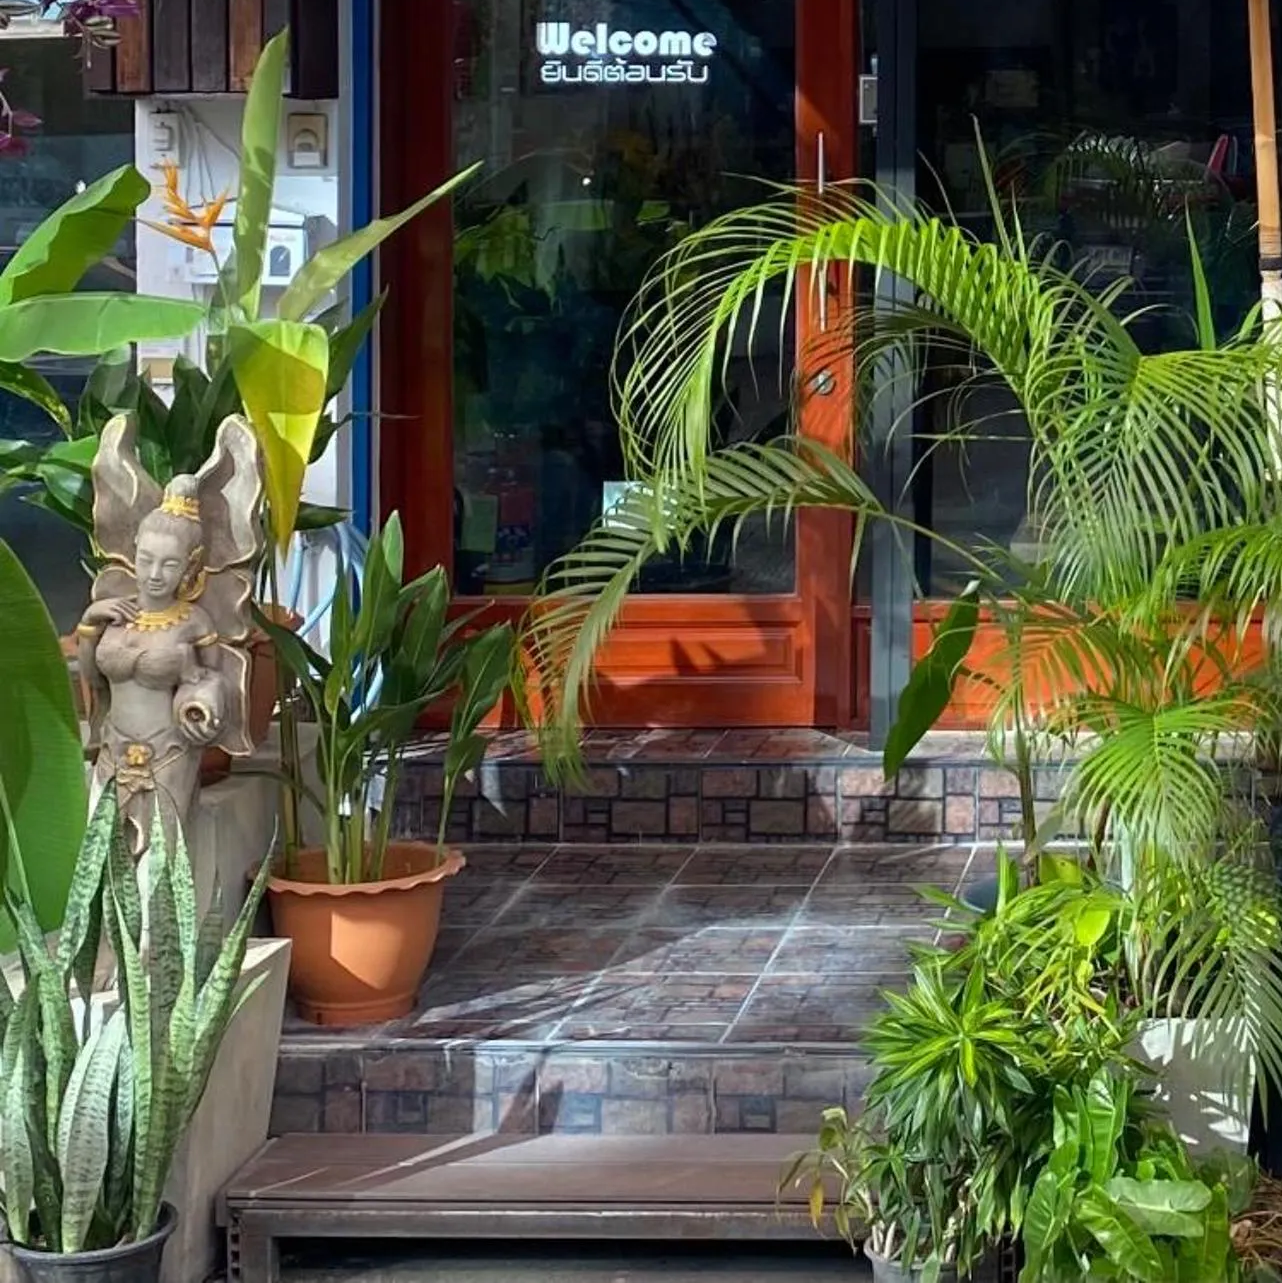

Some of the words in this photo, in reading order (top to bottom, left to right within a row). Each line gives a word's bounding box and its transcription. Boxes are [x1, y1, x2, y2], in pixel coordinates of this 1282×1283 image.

[536, 22, 718, 57] Welcome
[540, 57, 709, 83] ยินดีต้อนรับ
